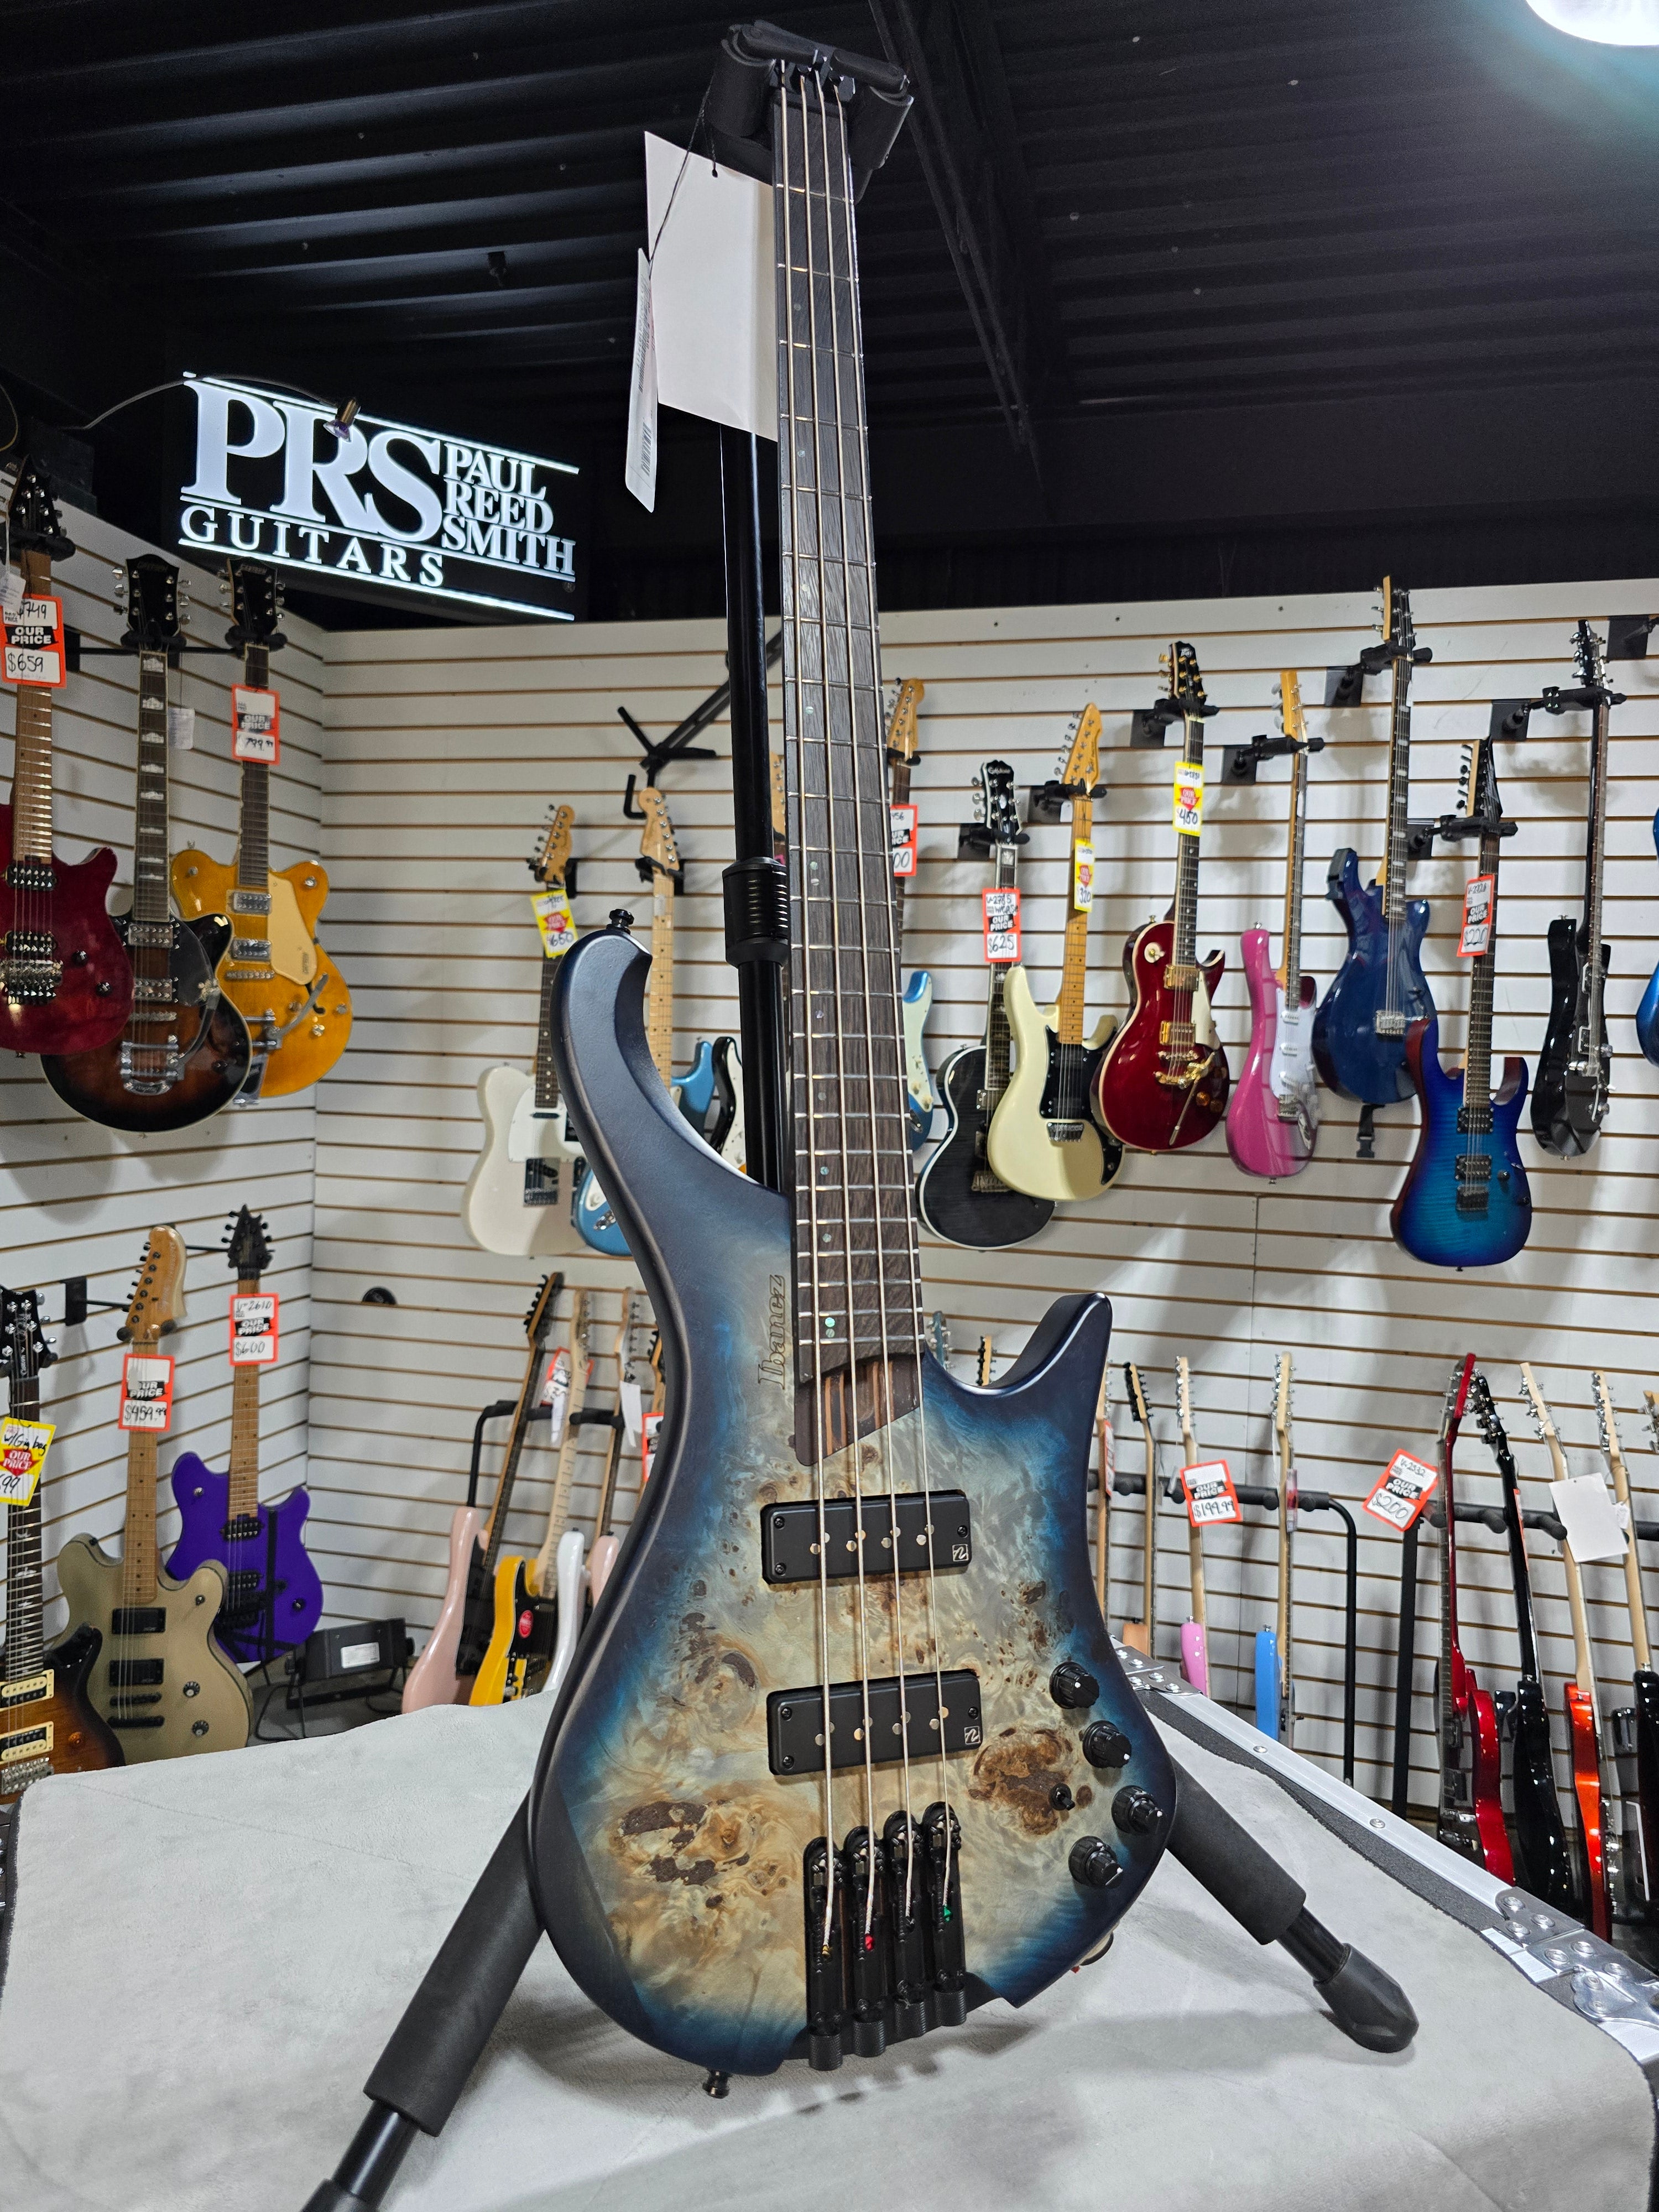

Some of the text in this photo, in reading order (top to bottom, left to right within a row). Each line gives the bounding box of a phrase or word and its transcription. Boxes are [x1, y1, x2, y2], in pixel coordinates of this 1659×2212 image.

[181, 380, 442, 542] PRS
[444, 442, 546, 500] PAUL
[444, 478, 554, 534] REED
[180, 504, 444, 587] GUITARS
[441, 514, 576, 576] SMITH
[15, 627, 44, 635] OUR
[11, 635, 52, 645] PRICE
[8, 652, 44, 672] $659
[243, 714, 265, 723] OUR
[1470, 904, 1485, 915] OUR
[992, 915, 1010, 924] OUR
[1467, 910, 1488, 924] PRICE
[990, 920, 1014, 932] PRICE
[988, 935, 1015, 953] $625
[238, 1323, 269, 1335] PRICE
[241, 1318, 264, 1328] OUR
[757, 1274, 785, 1390] Ibanez
[235, 1340, 265, 1357] $600
[129, 1387, 163, 1399] PRICE
[9, 1450, 31, 1461] OUR
[3, 1458, 33, 1470] PRICE
[1196, 1481, 1217, 1493] OUR
[1385, 1482, 1420, 1500] PRICE
[1392, 1478, 1416, 1491] OUR
[1194, 1485, 1225, 1500] PRICE
